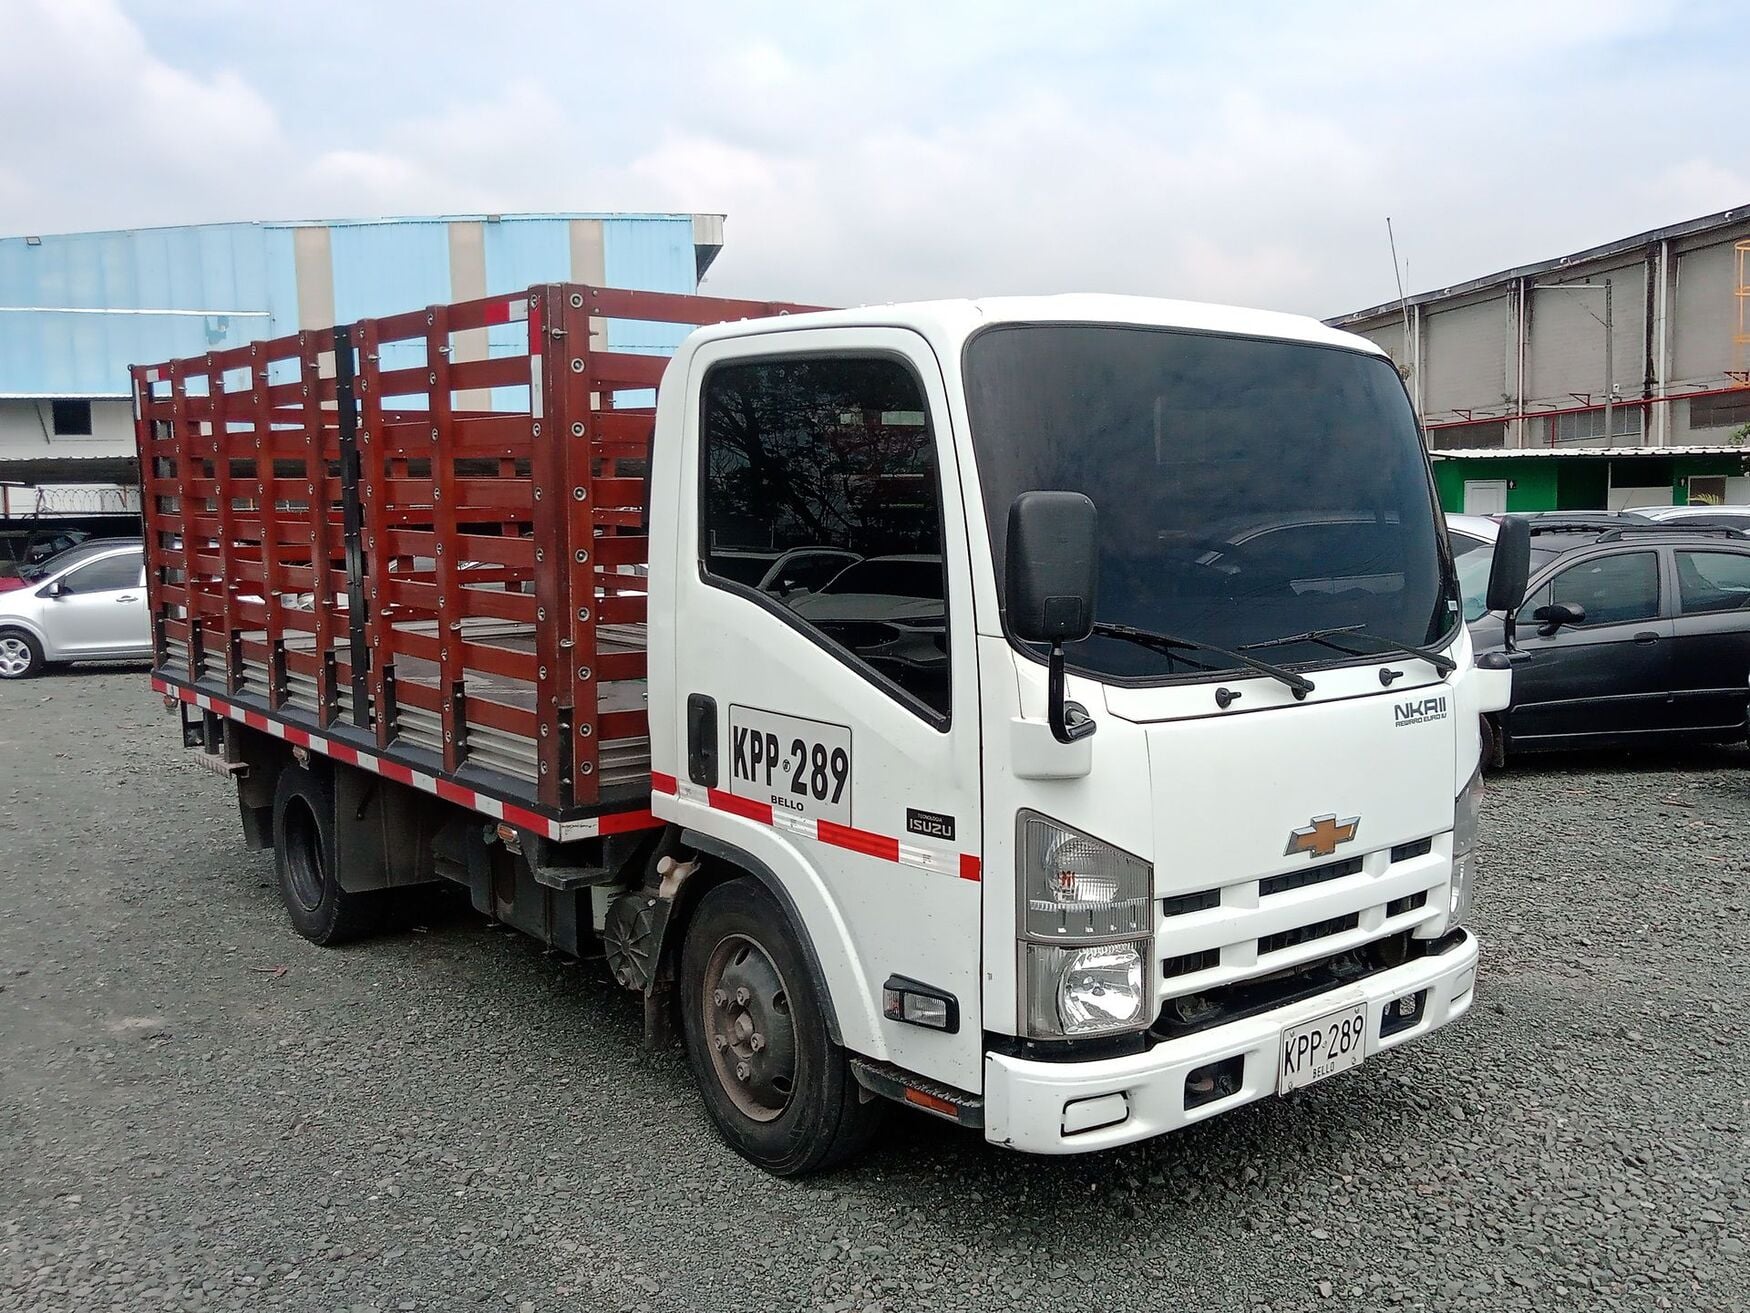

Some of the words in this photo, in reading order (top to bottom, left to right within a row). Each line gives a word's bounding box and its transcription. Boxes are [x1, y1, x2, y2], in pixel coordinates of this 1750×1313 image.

[771, 794, 804, 812] BELLO
[909, 818, 952, 837] ISUZU
[1312, 1061, 1335, 1079] BELLO
